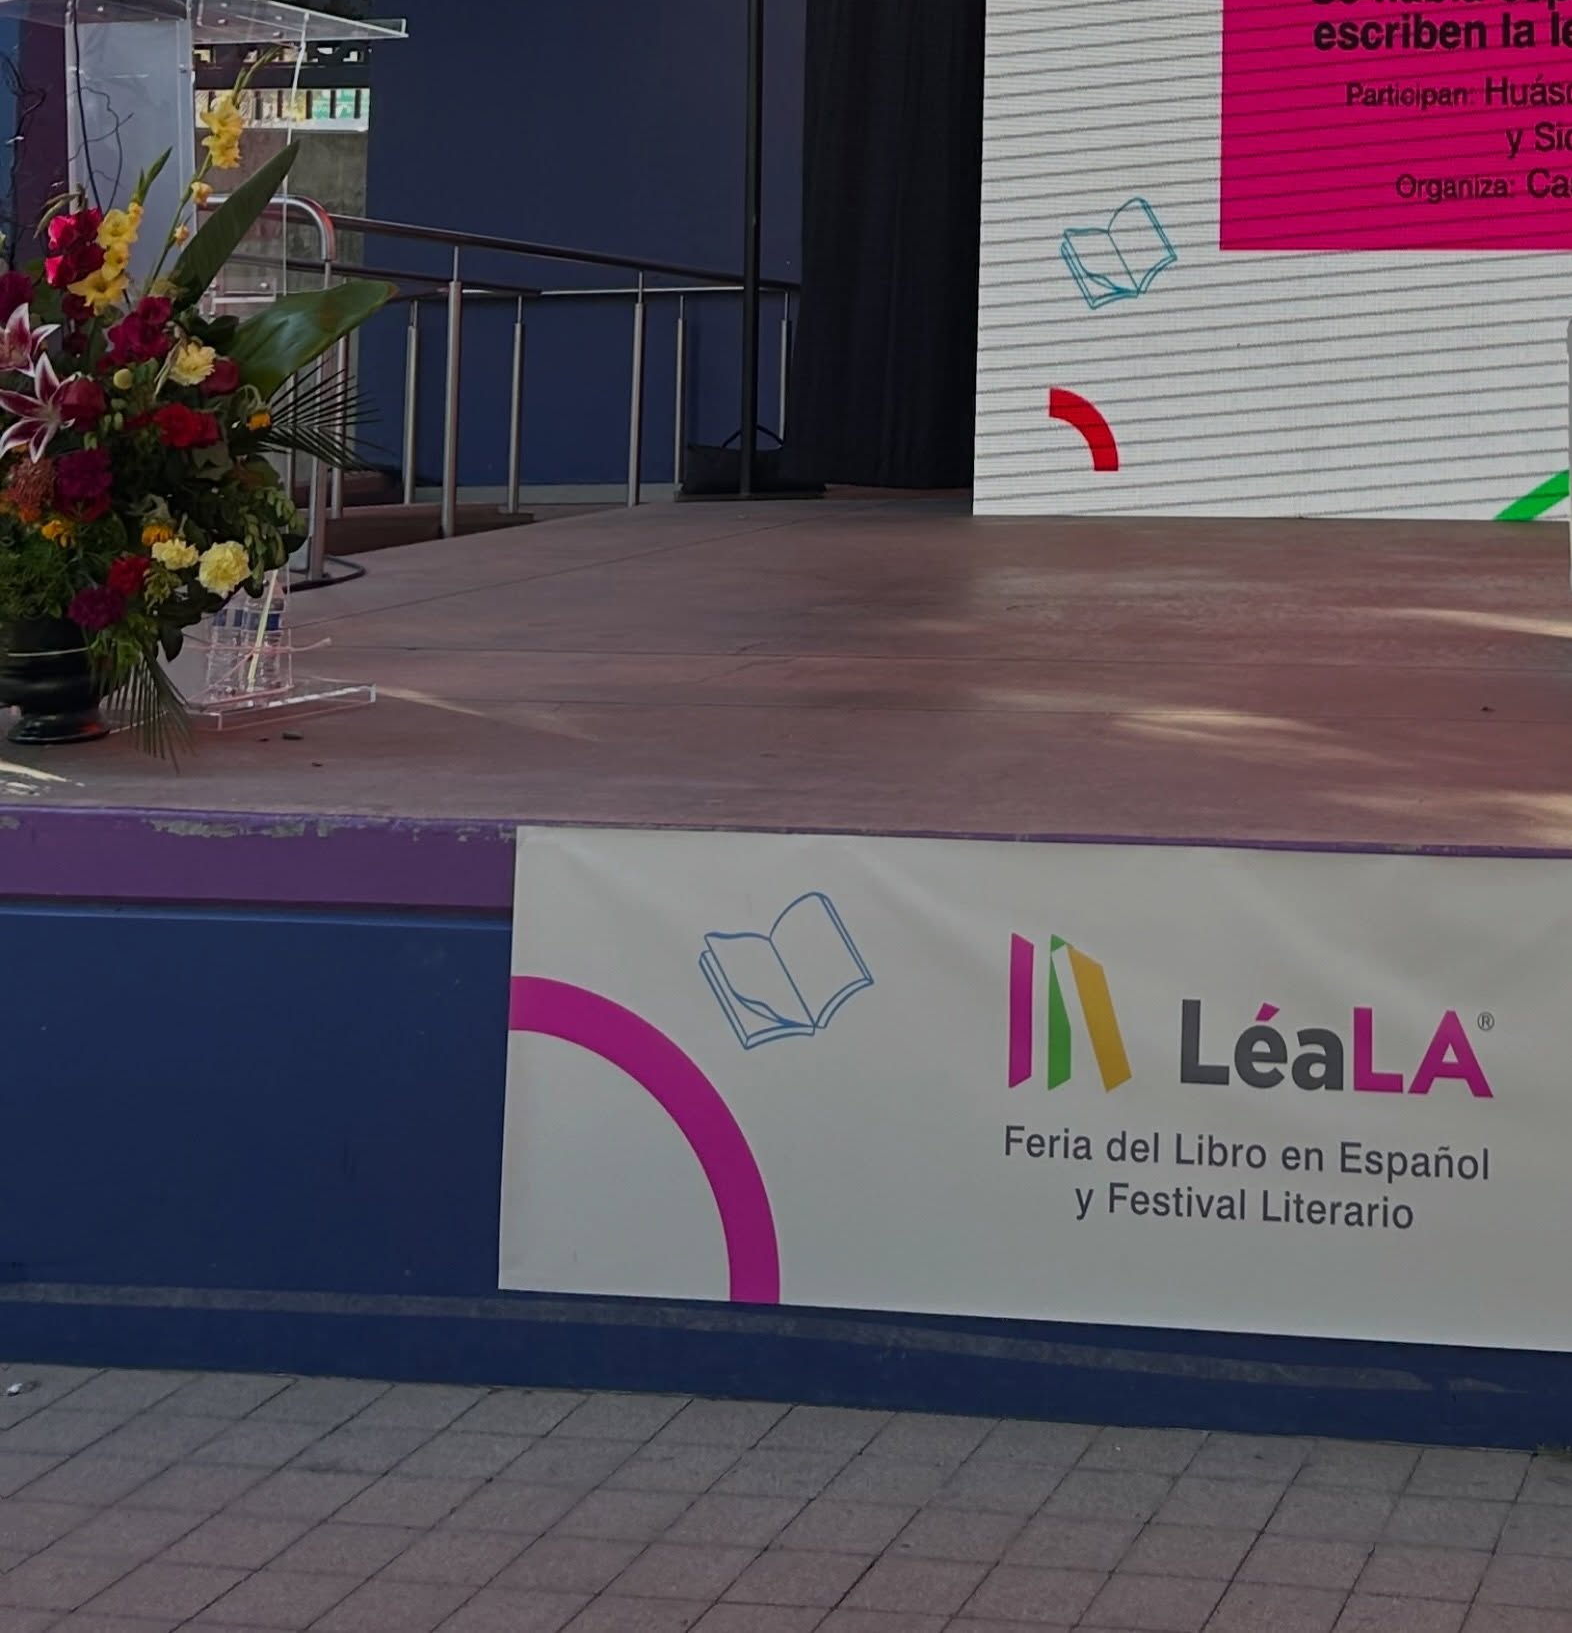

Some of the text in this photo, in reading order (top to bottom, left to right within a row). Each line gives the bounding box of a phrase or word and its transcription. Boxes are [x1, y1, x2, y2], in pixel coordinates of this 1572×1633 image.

[1313, 13, 1488, 51] escriben
[1501, 12, 1538, 49] la
[1345, 81, 1475, 113] Participan:
[1506, 128, 1523, 159] y
[1395, 174, 1516, 205] Organiza:
[1004, 1124, 1490, 1185] Feria del Libro en Español
[1075, 1181, 1415, 1230] y Festival Literario
